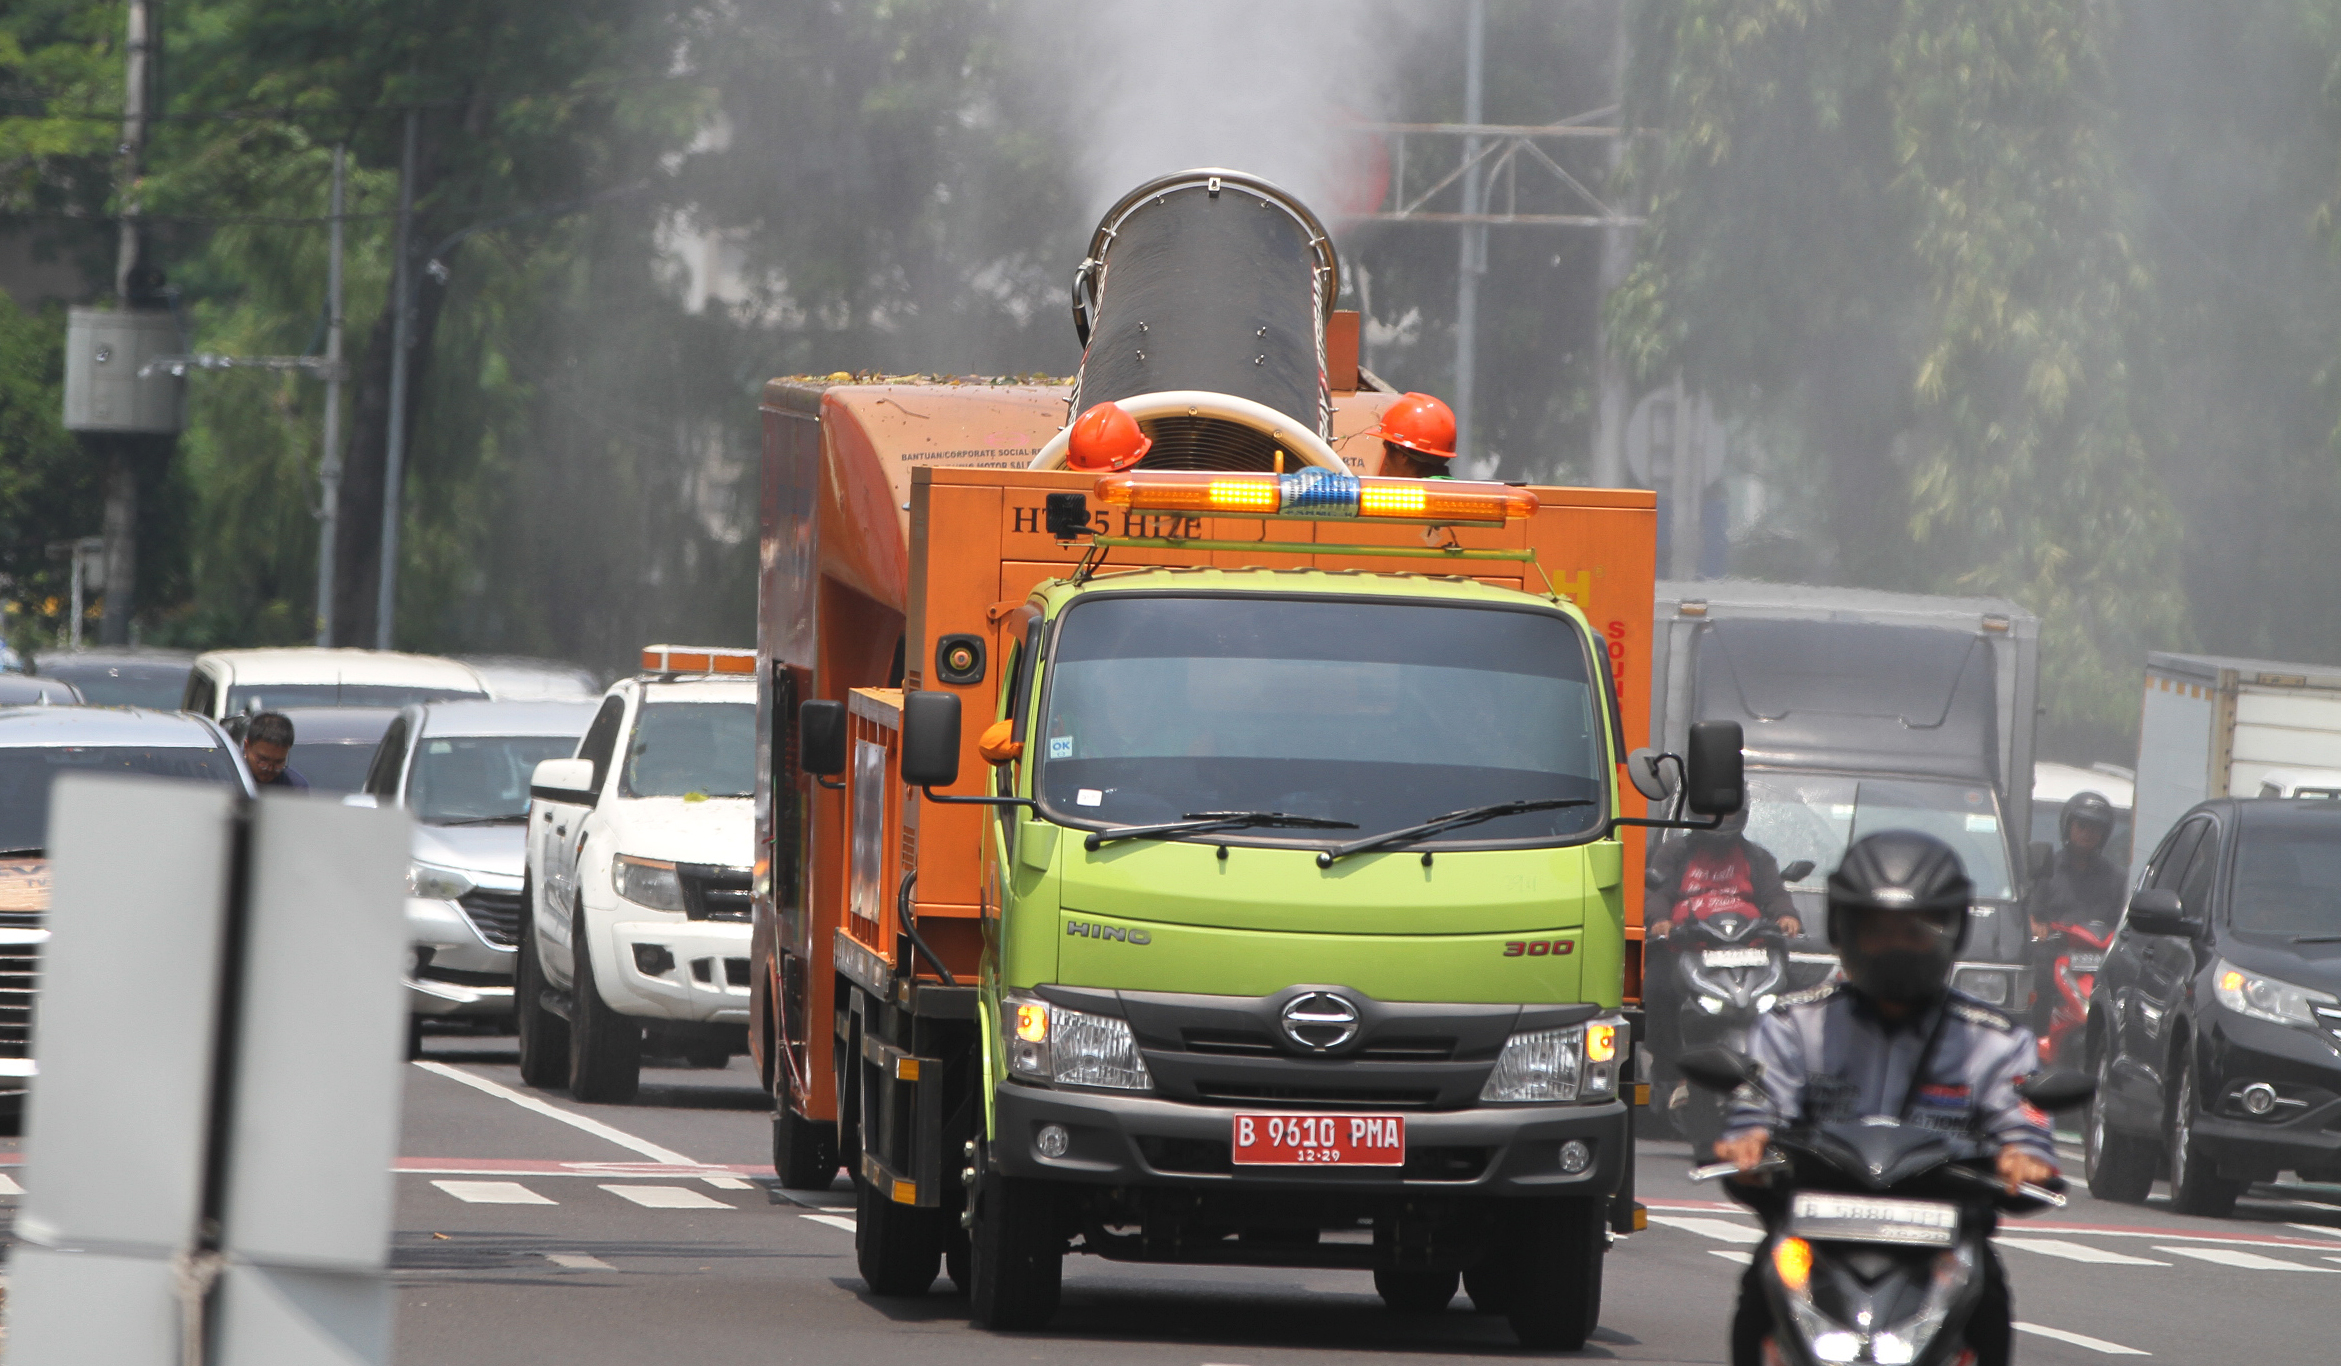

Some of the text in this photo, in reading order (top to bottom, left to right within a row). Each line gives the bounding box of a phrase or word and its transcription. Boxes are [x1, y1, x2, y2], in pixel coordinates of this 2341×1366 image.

[999, 448, 1029, 456] SOCIAL
[1052, 741, 1071, 751] OK
[1067, 920, 1152, 946] HINO
[1503, 940, 1575, 957] 300
[1239, 1117, 1400, 1149] B 9610 PMA
